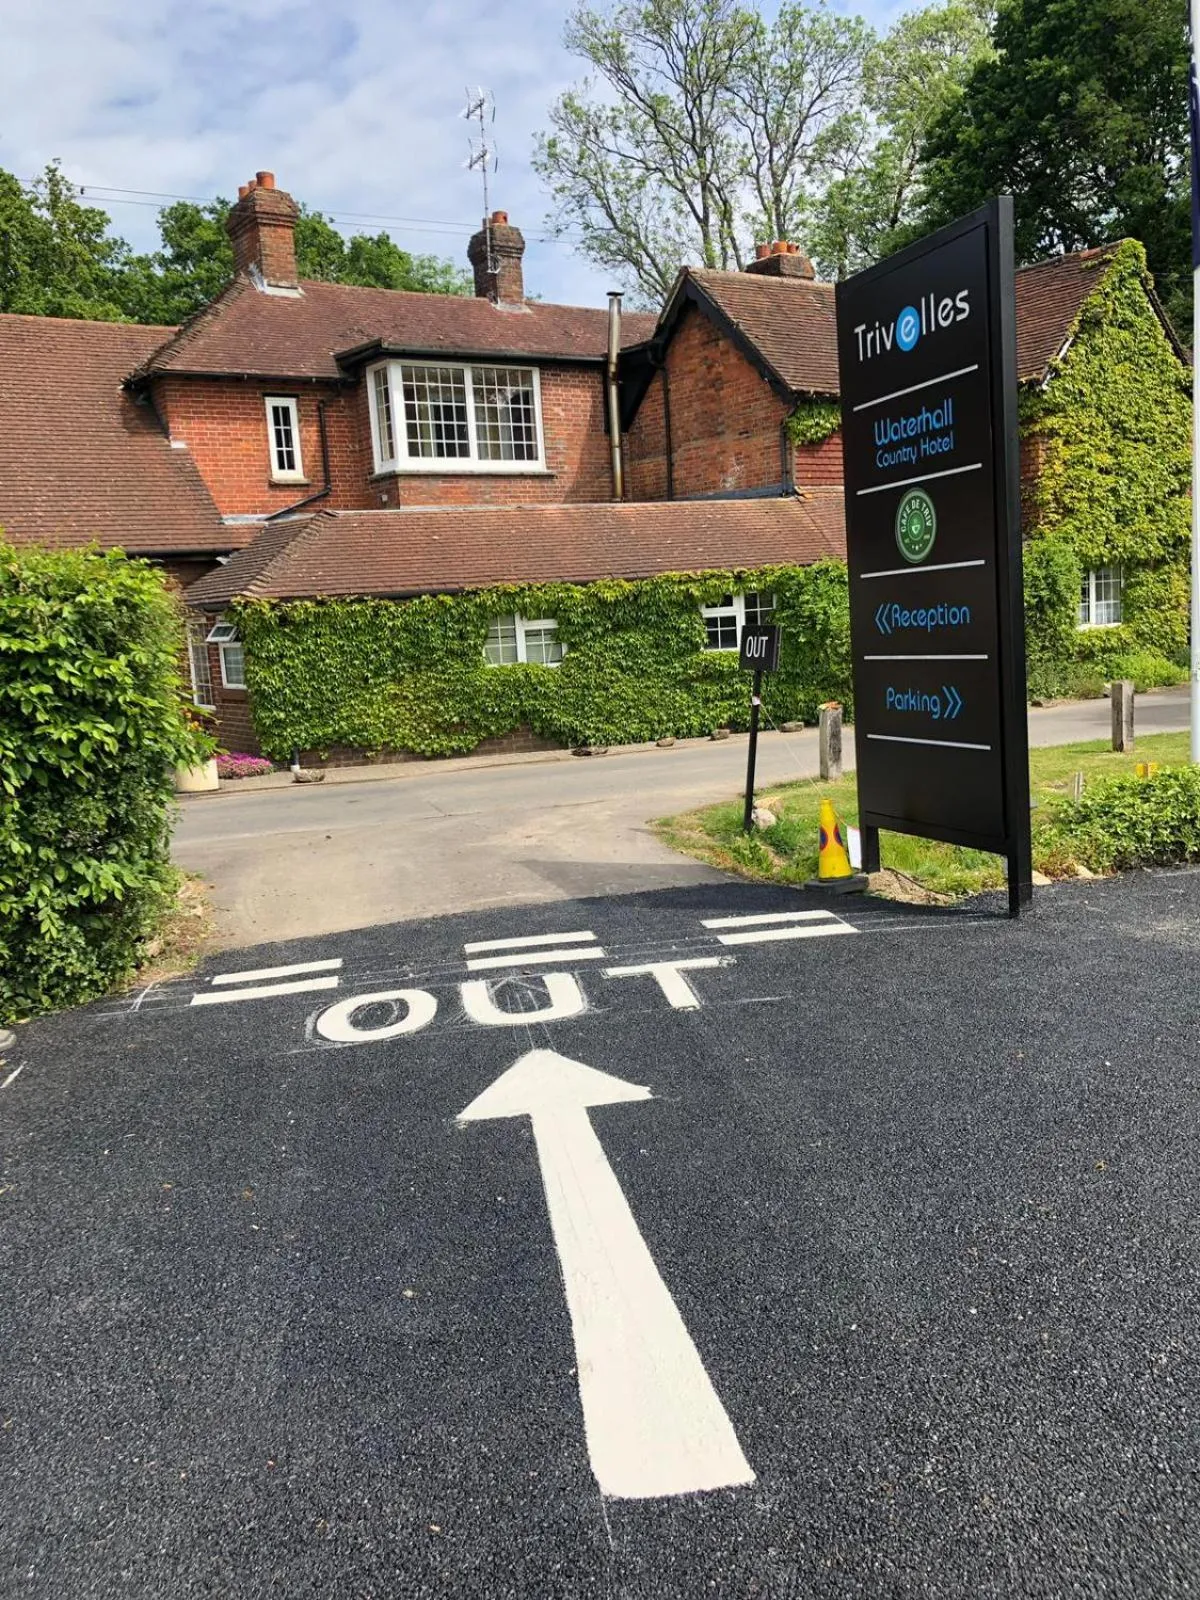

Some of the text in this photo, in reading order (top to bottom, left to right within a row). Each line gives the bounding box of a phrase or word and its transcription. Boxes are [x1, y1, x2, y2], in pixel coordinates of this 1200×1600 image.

[854, 289, 970, 361] Trivelles
[874, 398, 953, 446] Waterhall
[876, 432, 954, 468] Country Hotel
[911, 499, 920, 509] DE
[891, 603, 970, 632] Reception
[745, 635, 768, 658] OUT
[886, 687, 940, 719] Parking
[316, 956, 722, 1041] OUT
